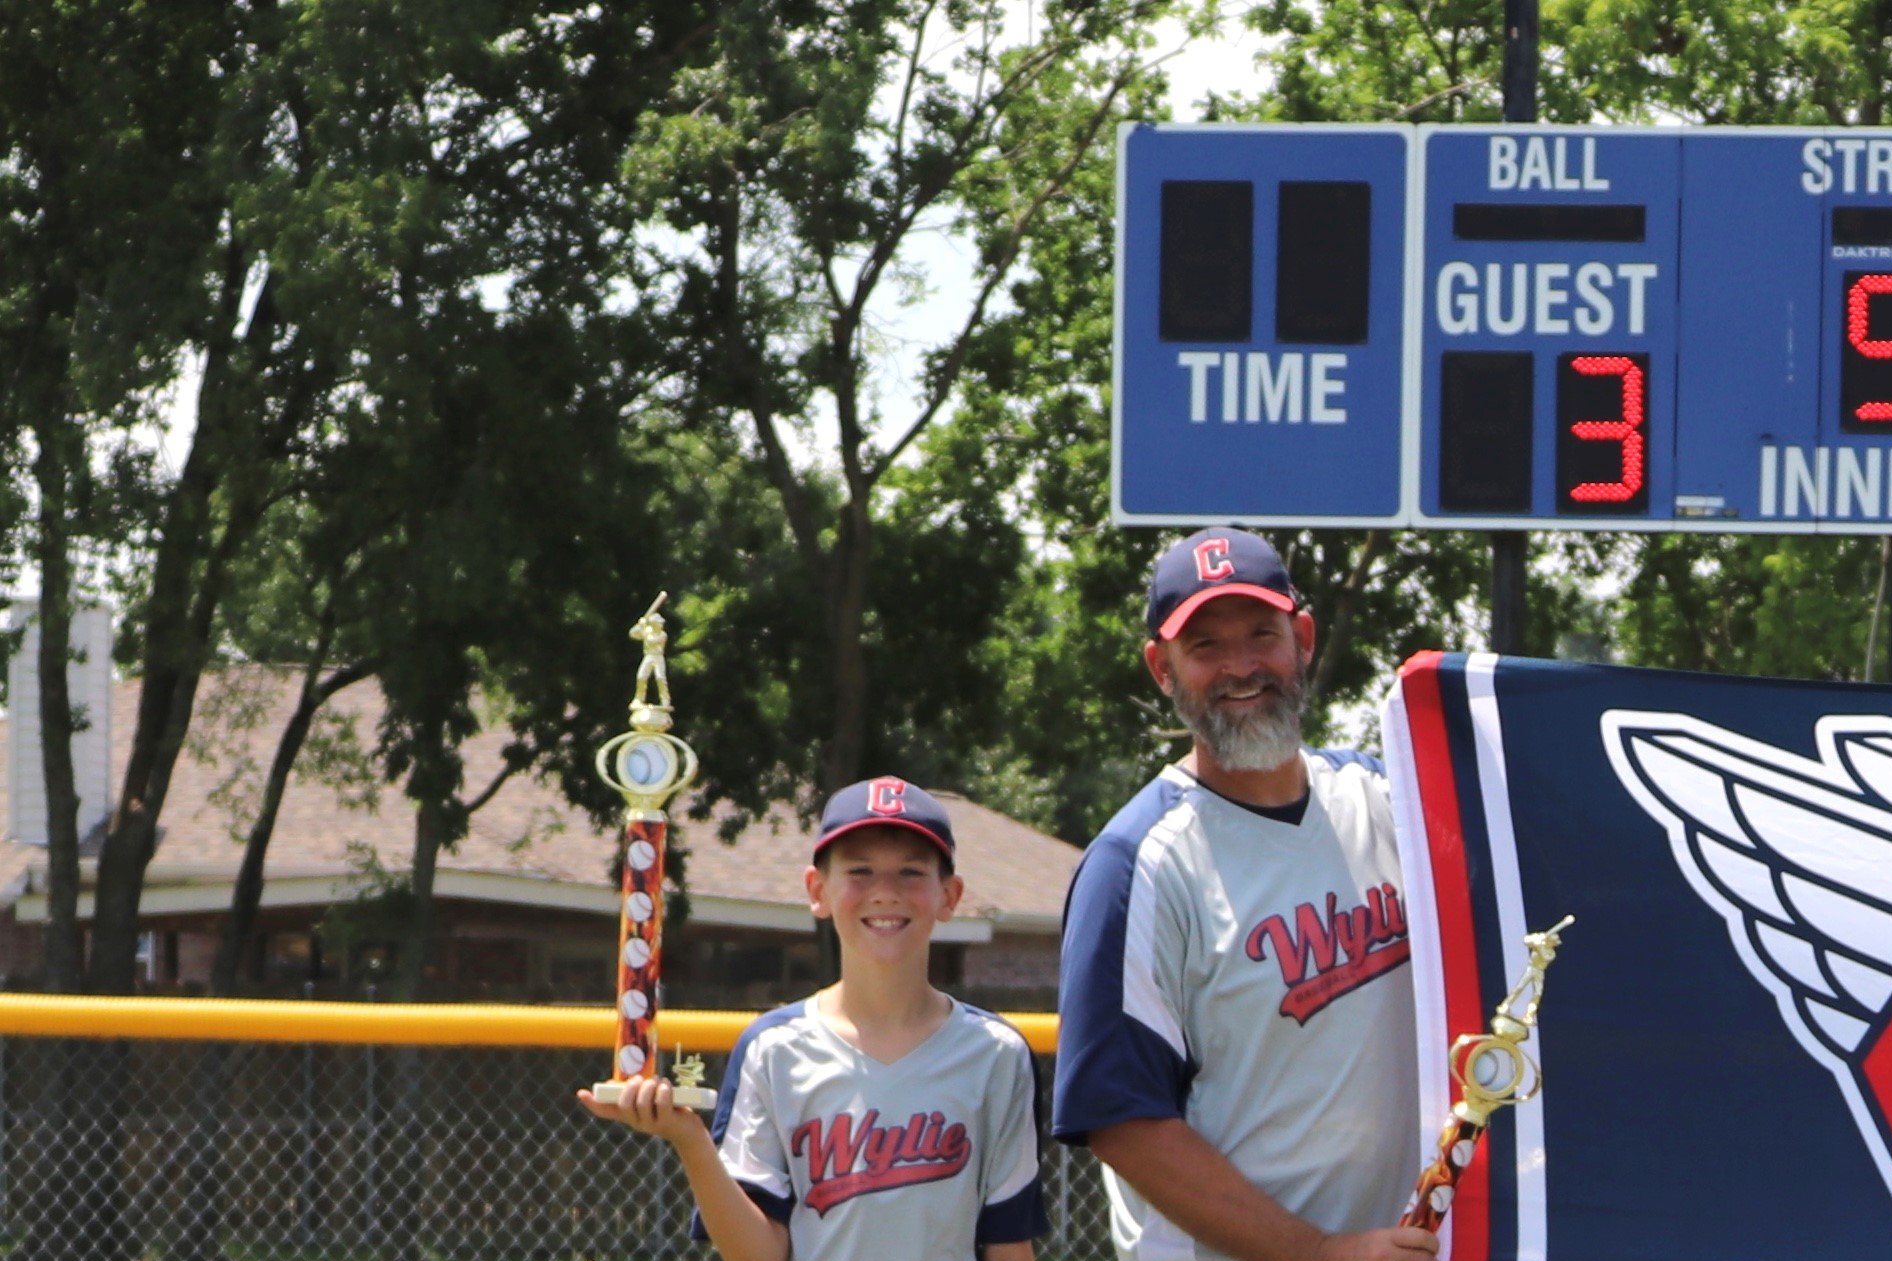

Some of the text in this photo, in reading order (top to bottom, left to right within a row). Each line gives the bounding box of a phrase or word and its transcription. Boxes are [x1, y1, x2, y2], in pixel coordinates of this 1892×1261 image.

[1488, 136, 1610, 191] BALL
[1436, 261, 1658, 335] GUEST
[1177, 352, 1348, 424] TIME
[1570, 355, 1645, 502] 3
[1194, 537, 1233, 583] C
[867, 779, 906, 815] C
[1245, 881, 1409, 988] Wyli
[791, 1108, 972, 1185] Wylie
